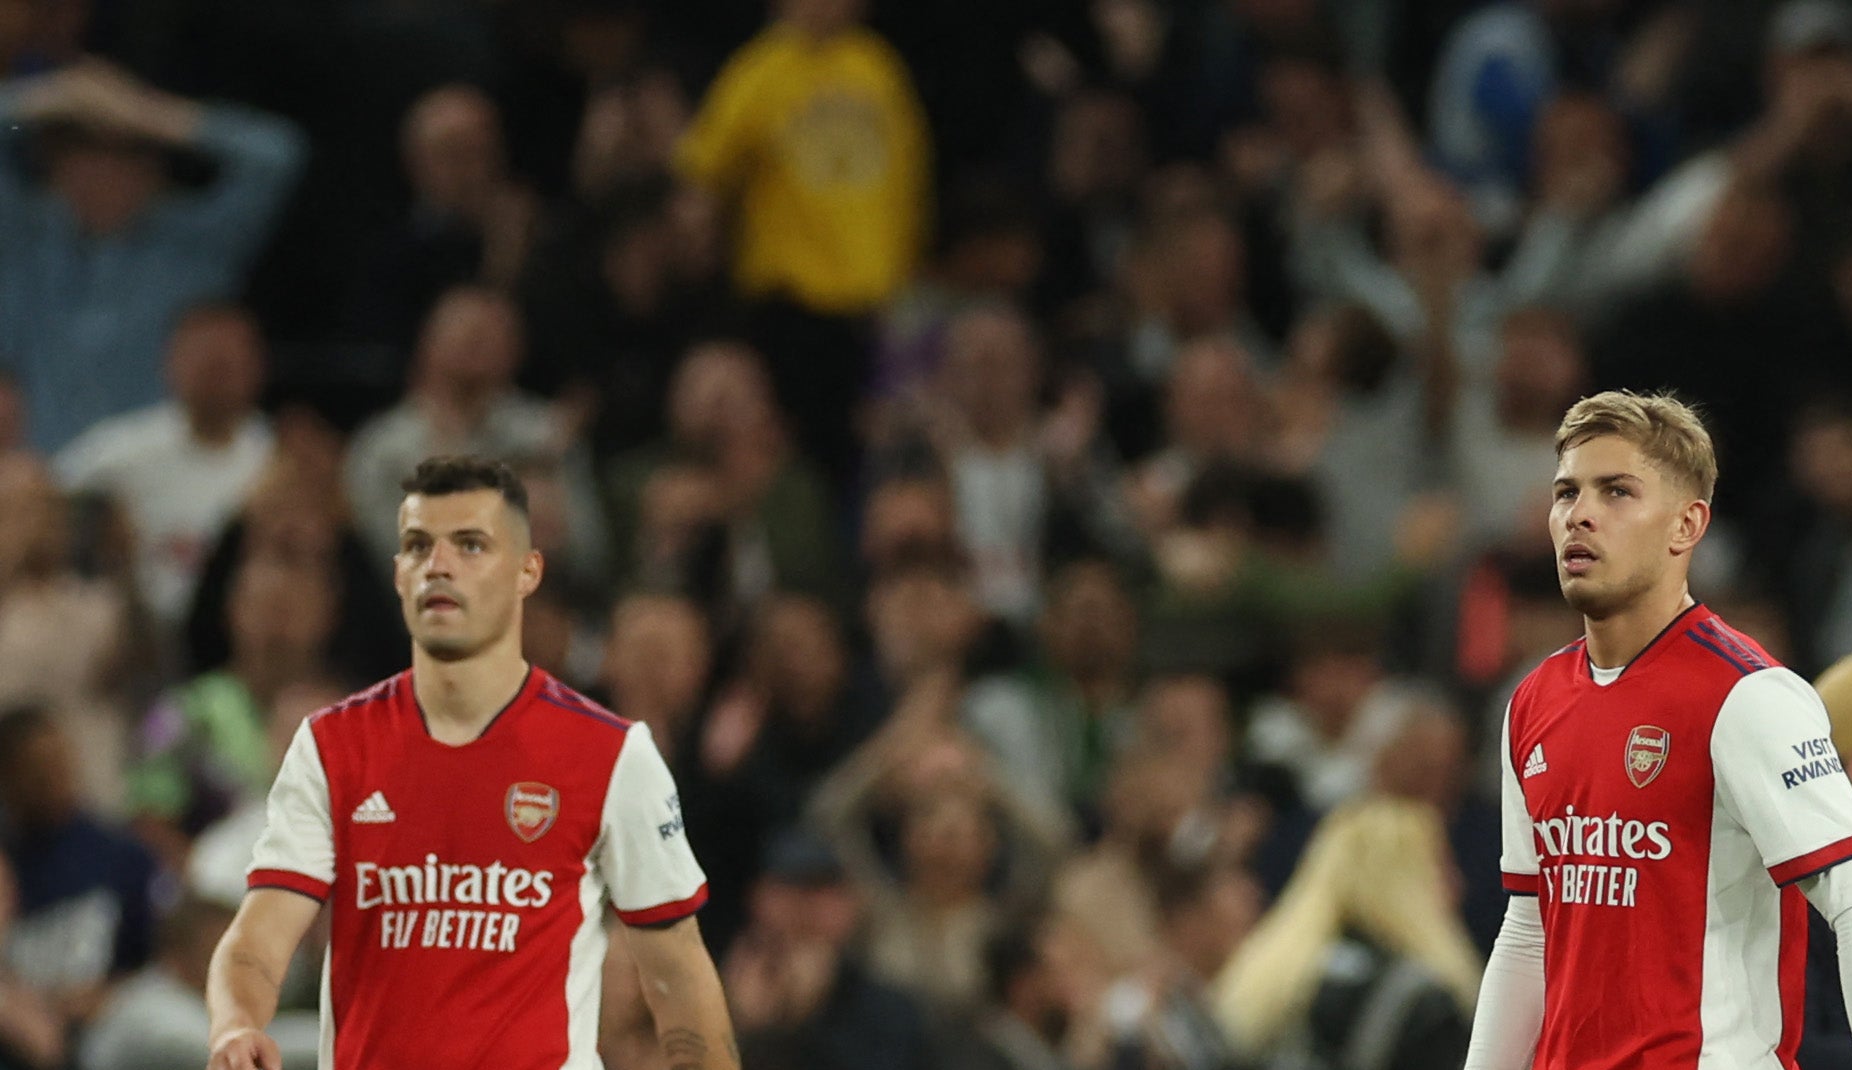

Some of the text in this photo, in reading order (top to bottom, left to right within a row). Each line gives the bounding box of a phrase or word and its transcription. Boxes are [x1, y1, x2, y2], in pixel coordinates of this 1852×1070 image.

[1792, 738, 1831, 759] VISIT
[1533, 804, 1672, 860] mirates
[355, 853, 554, 910] Emirates
[1561, 864, 1638, 907] BETTER
[421, 909, 520, 952] BETTER
